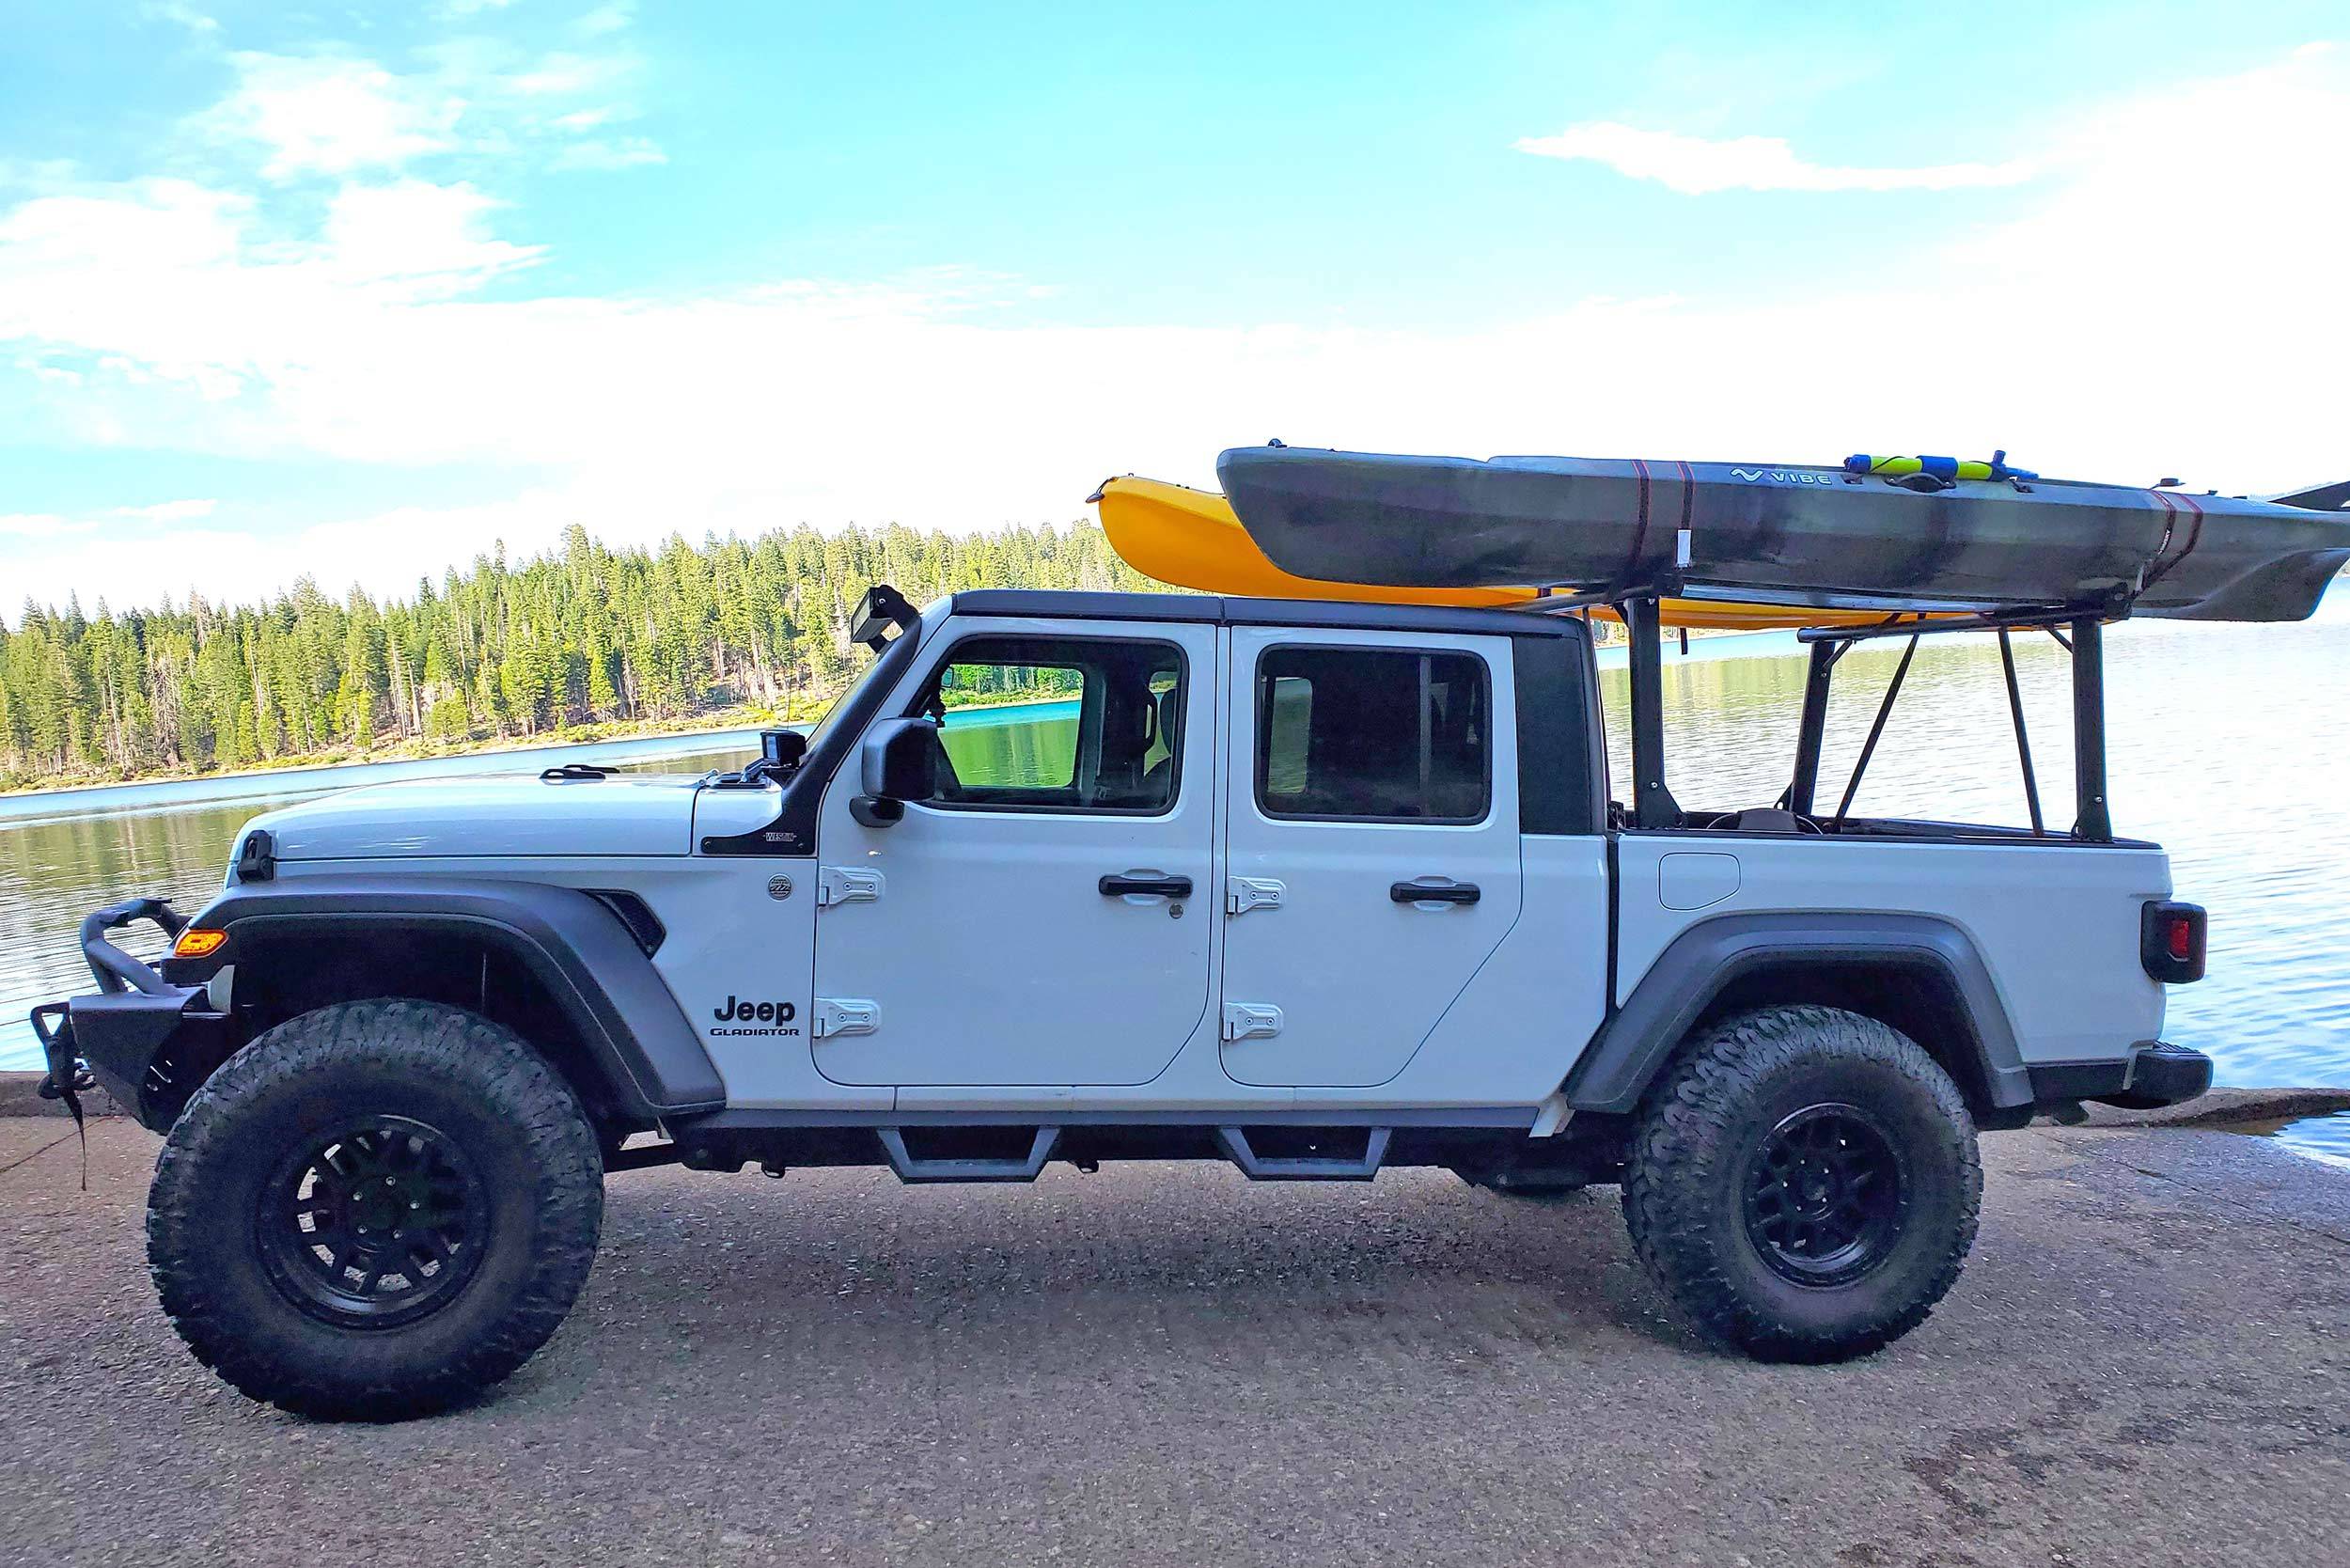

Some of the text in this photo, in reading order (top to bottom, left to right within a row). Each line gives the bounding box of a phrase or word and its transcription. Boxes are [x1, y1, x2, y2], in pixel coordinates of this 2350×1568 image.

[1771, 472, 1832, 485] VIBE
[714, 996, 795, 1027] Jeep
[710, 1027, 800, 1036] GLADIATOR
